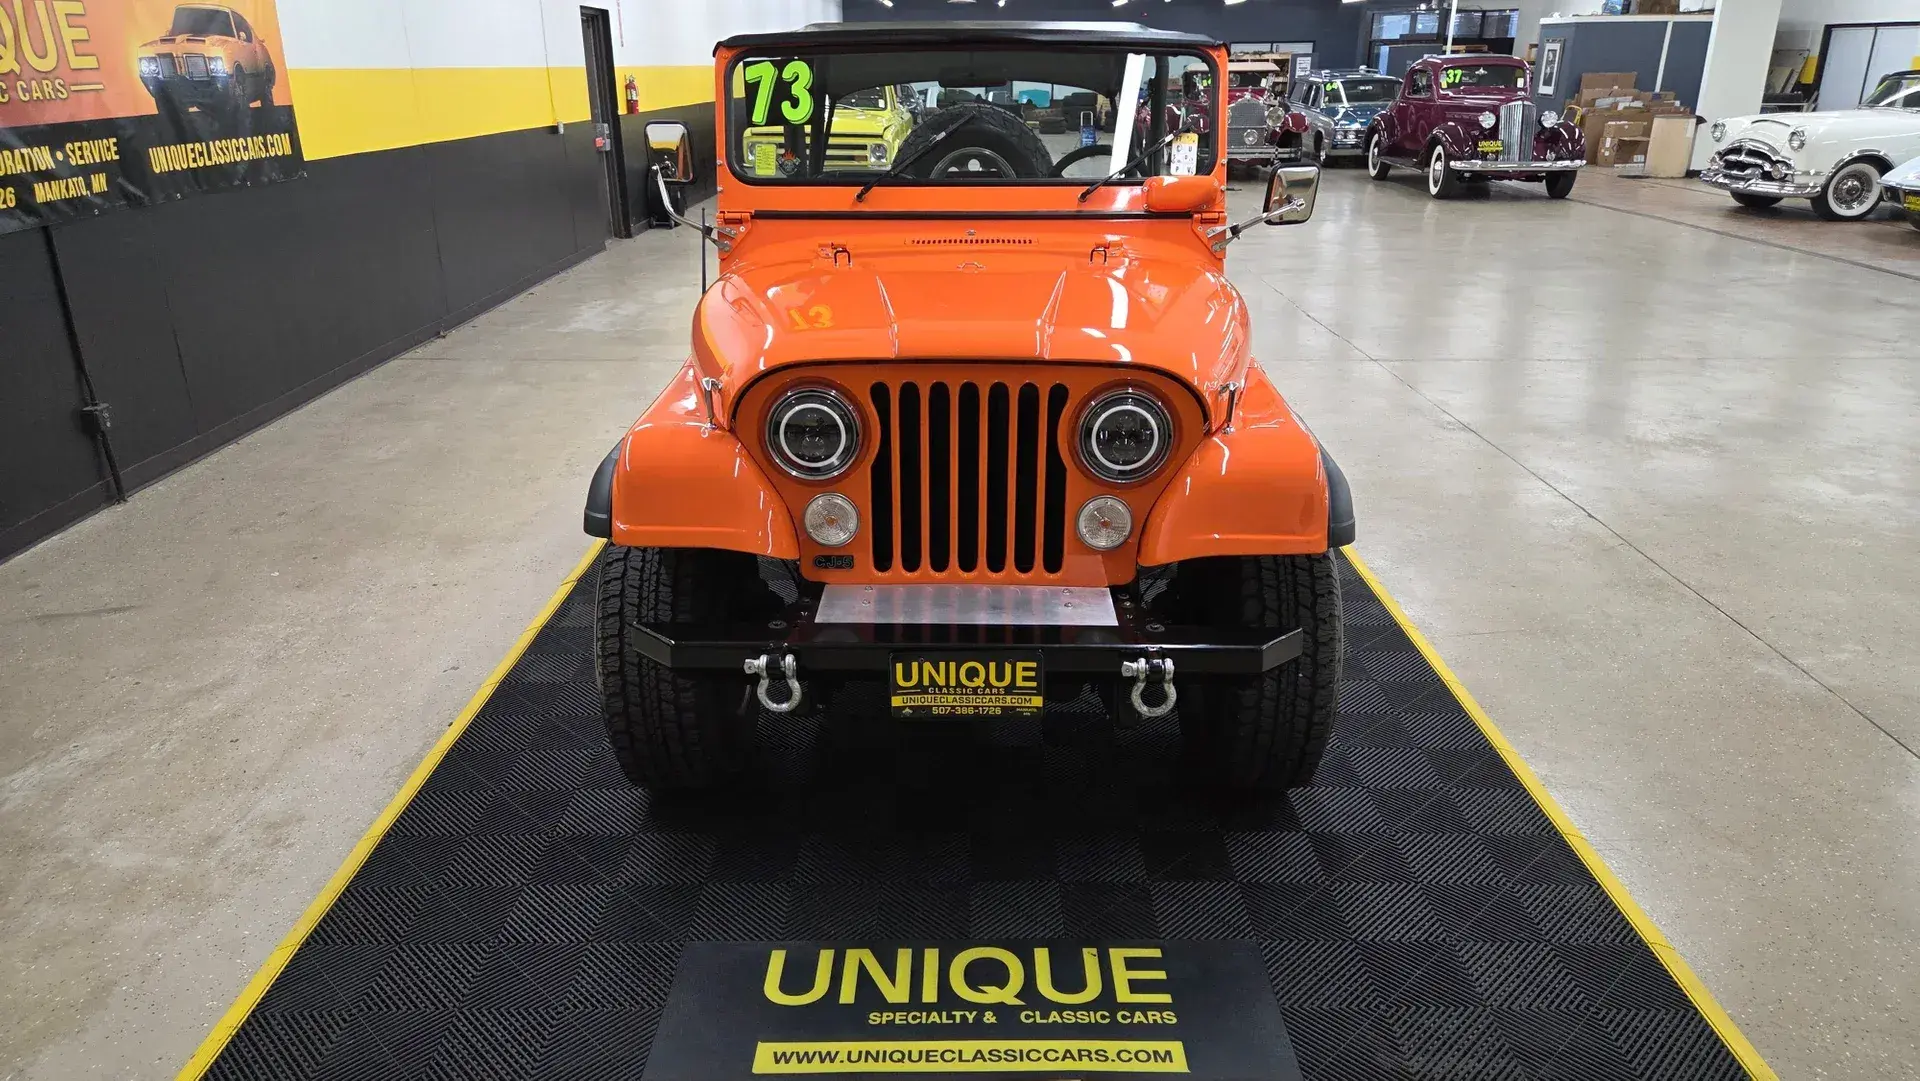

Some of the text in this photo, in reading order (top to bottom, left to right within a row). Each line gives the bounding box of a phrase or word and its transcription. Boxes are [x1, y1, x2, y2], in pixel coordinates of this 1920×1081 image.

[1446, 69, 1463, 84] 37
[16, 78, 68, 102] CARS
[745, 60, 814, 126] 73
[65, 137, 120, 166] SERVICE
[148, 132, 293, 174] UNIQUECLASSICCARS.COM
[33, 176, 91, 204] MANKATO,
[90, 172, 109, 194] MN
[895, 661, 1038, 688] UNIQUE
[901, 695, 1033, 705] UNIQUECLASSICCARS.COM
[928, 687, 1006, 695] CLASSIC CARS
[931, 706, 1002, 715] 507-386-1726
[762, 946, 1174, 1006] UNIQUE
[867, 1010, 1179, 1025] SPECIALTY & CLASSIC CARS
[772, 1048, 1175, 1065] WWW.UNIQUECLASSICCARS.COM
